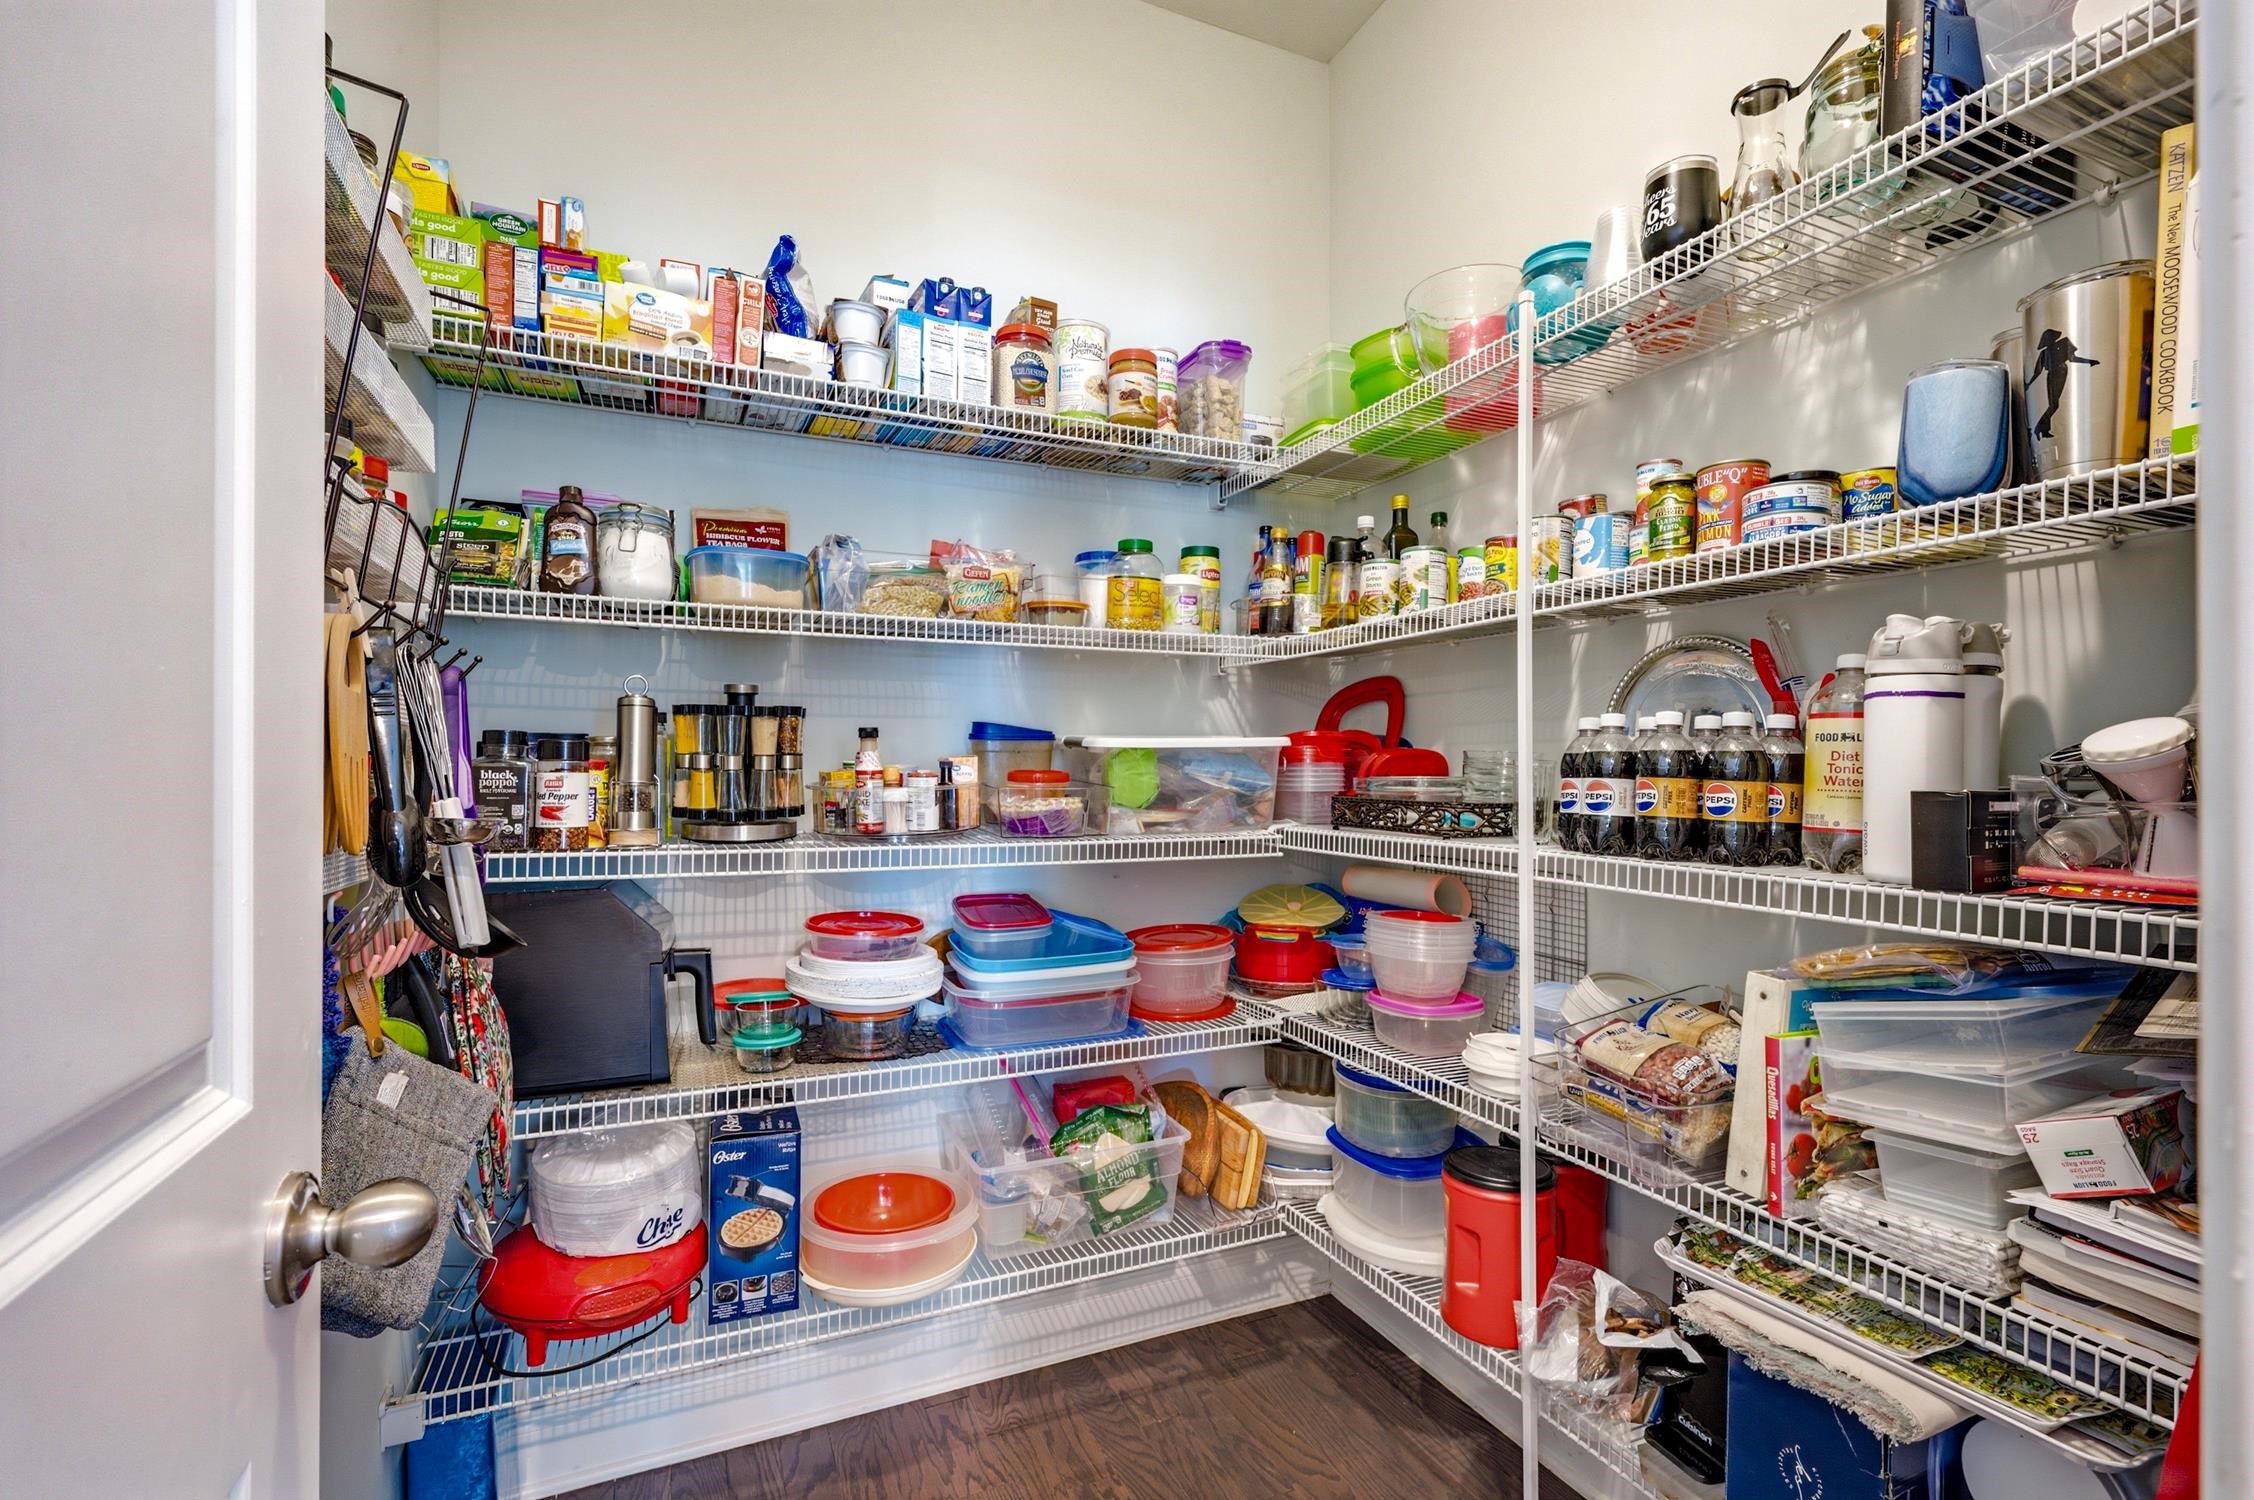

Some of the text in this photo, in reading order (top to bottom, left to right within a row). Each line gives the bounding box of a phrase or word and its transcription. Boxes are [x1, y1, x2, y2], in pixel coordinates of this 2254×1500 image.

[2167, 142, 2186, 193] KATZEN
[1645, 185, 1677, 206] heers
[1646, 194, 1676, 226] 65
[2167, 203, 2181, 221] The
[427, 221, 457, 233] good
[2167, 222, 2181, 244] New
[430, 271, 460, 283] good
[2160, 244, 2181, 335] MOOSEWOOD
[1072, 336, 1104, 353] Nature's
[2157, 339, 2177, 415] COOKBOOK
[1698, 469, 1723, 488] UBLE
[1844, 491, 1894, 505] No Sugar
[1851, 503, 1884, 513] Added
[439, 530, 465, 538] PSTO
[703, 520, 748, 537] Premium
[706, 532, 780, 545] HIBISCUS FLOWER
[725, 540, 748, 548] BAGS
[455, 541, 490, 551] steep
[1202, 571, 1220, 579] Lipto
[952, 580, 1004, 594] Ramen
[1815, 733, 1838, 742] FOOD
[1830, 750, 1861, 762] Diet
[480, 769, 515, 780] black
[1827, 763, 1863, 775] Tonic
[547, 792, 579, 802] Pepper
[1585, 792, 1612, 801] PEPSI
[1706, 796, 1735, 805] PEPSI
[1766, 1066, 1779, 1120] Quesadillas
[2022, 1133, 2040, 1144] 25
[712, 1150, 747, 1165] Oster
[1096, 1151, 1140, 1184] ALMOND
[2087, 1166, 2105, 1174] Quart
[1107, 1166, 1136, 1187] FLOUR
[2097, 1180, 2117, 1188] FOOD
[1678, 1415, 1713, 1447] Cuisinart
